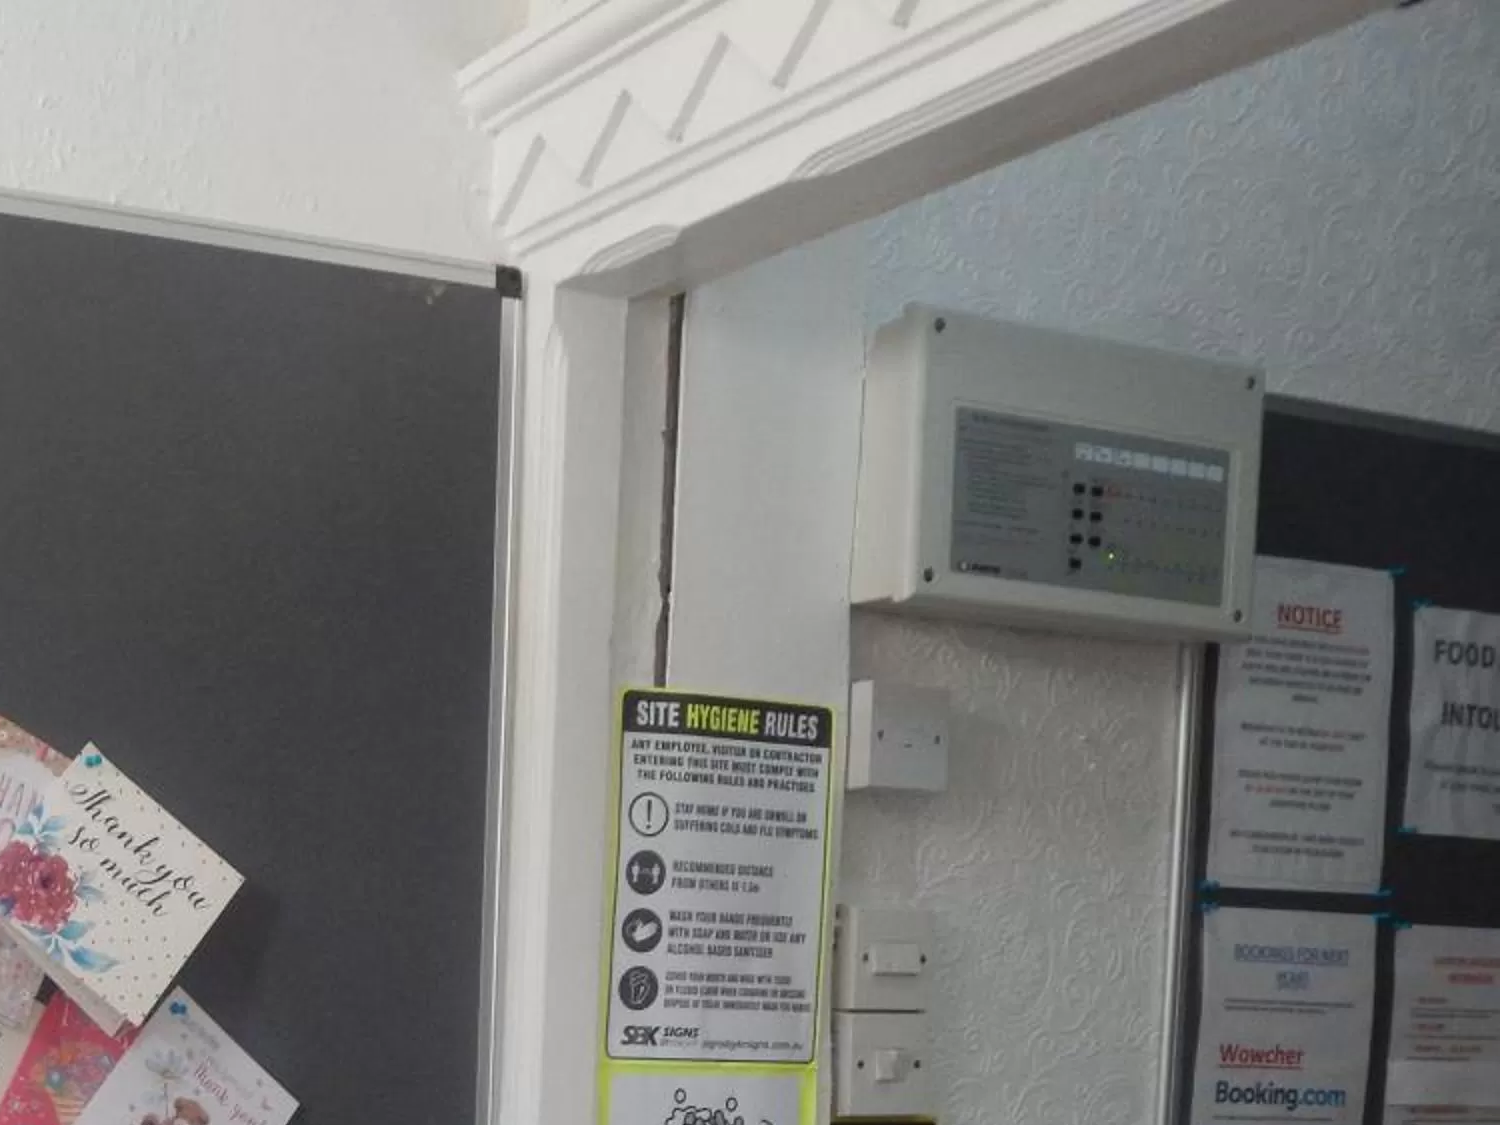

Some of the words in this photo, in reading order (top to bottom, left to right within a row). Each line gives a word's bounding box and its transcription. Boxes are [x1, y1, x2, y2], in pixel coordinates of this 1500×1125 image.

[1277, 604, 1342, 628] NOTICE
[1433, 639, 1496, 669] FOOD
[637, 701, 680, 727] SITE
[687, 704, 760, 734] HYGIENE
[765, 712, 819, 739] RULES
[69, 783, 160, 866] Thank
[134, 863, 211, 911] you
[100, 857, 172, 918] much
[1219, 1044, 1304, 1065] Wowcher
[1215, 1081, 1346, 1110] Booking.com
